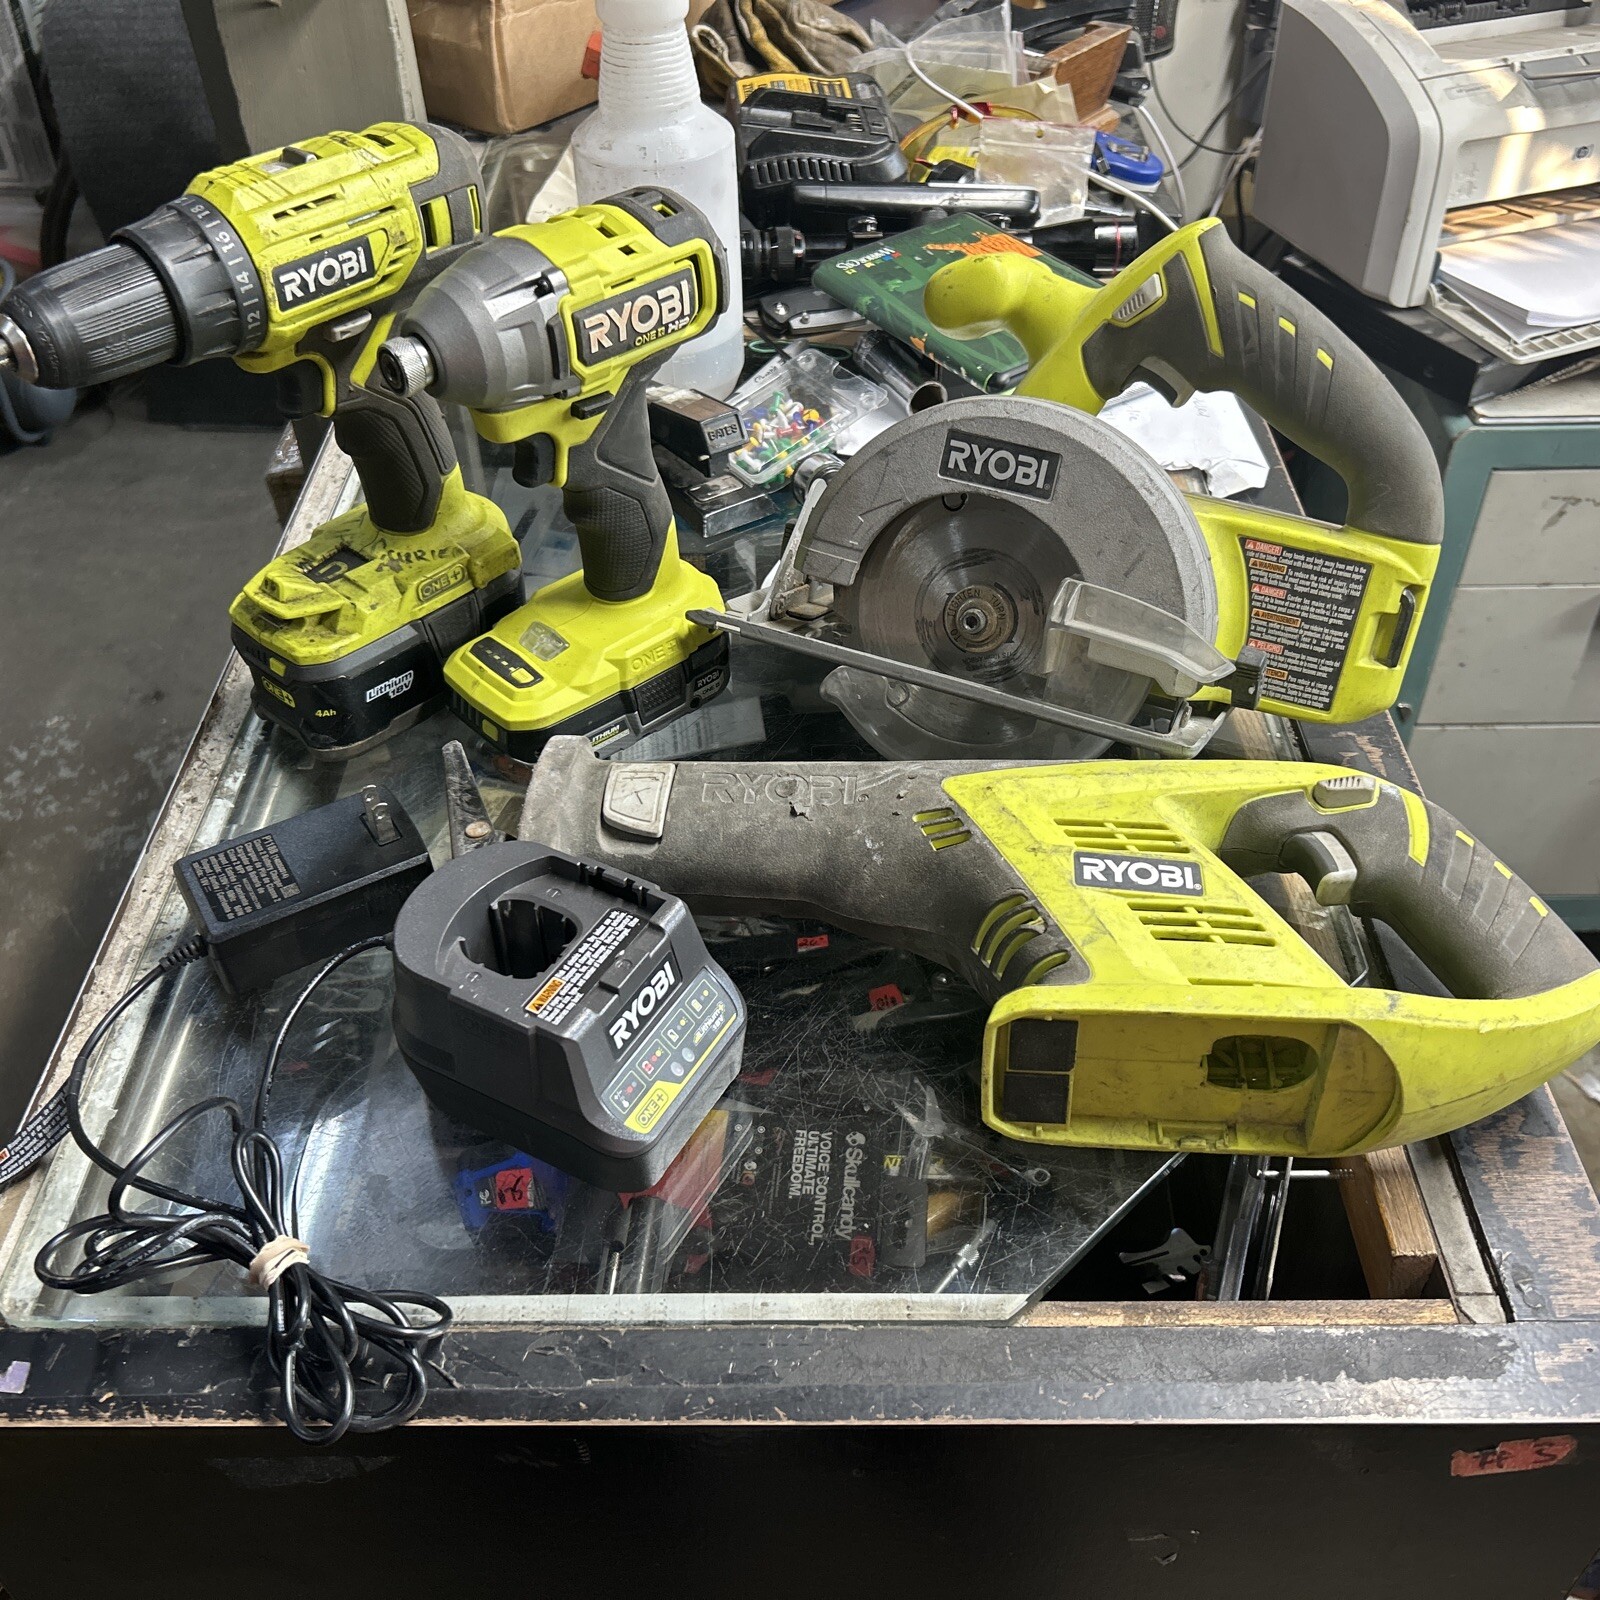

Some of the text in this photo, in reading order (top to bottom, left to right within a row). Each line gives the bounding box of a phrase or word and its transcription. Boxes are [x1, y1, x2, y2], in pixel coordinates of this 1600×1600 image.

[215, 231, 234, 253] 16
[236, 271, 254, 294] 14
[279, 246, 367, 301] RYOBI
[247, 310, 260, 330] 12
[584, 279, 690, 354] RYOBI
[948, 439, 1049, 489] RYOBI
[422, 570, 462, 596] ONE+
[1260, 561, 1286, 573] WARNING
[631, 638, 678, 671] ONE+
[368, 672, 412, 700] Lithium
[389, 682, 411, 697] 18V
[698, 671, 720, 688] RYOBI
[315, 709, 337, 717] 4Ah
[702, 772, 857, 806] RYOBI
[1080, 857, 1194, 890] RYOBI
[540, 980, 563, 1004] WARNING
[609, 961, 675, 1049] RYOBI
[637, 1093, 664, 1125] ONE+
[788, 1129, 807, 1199] FREEDOM.
[802, 1131, 820, 1195] ULTIMATE
[808, 1131, 833, 1246] VOICE CONTROL,
[834, 1149, 863, 1240] Skullcandy
